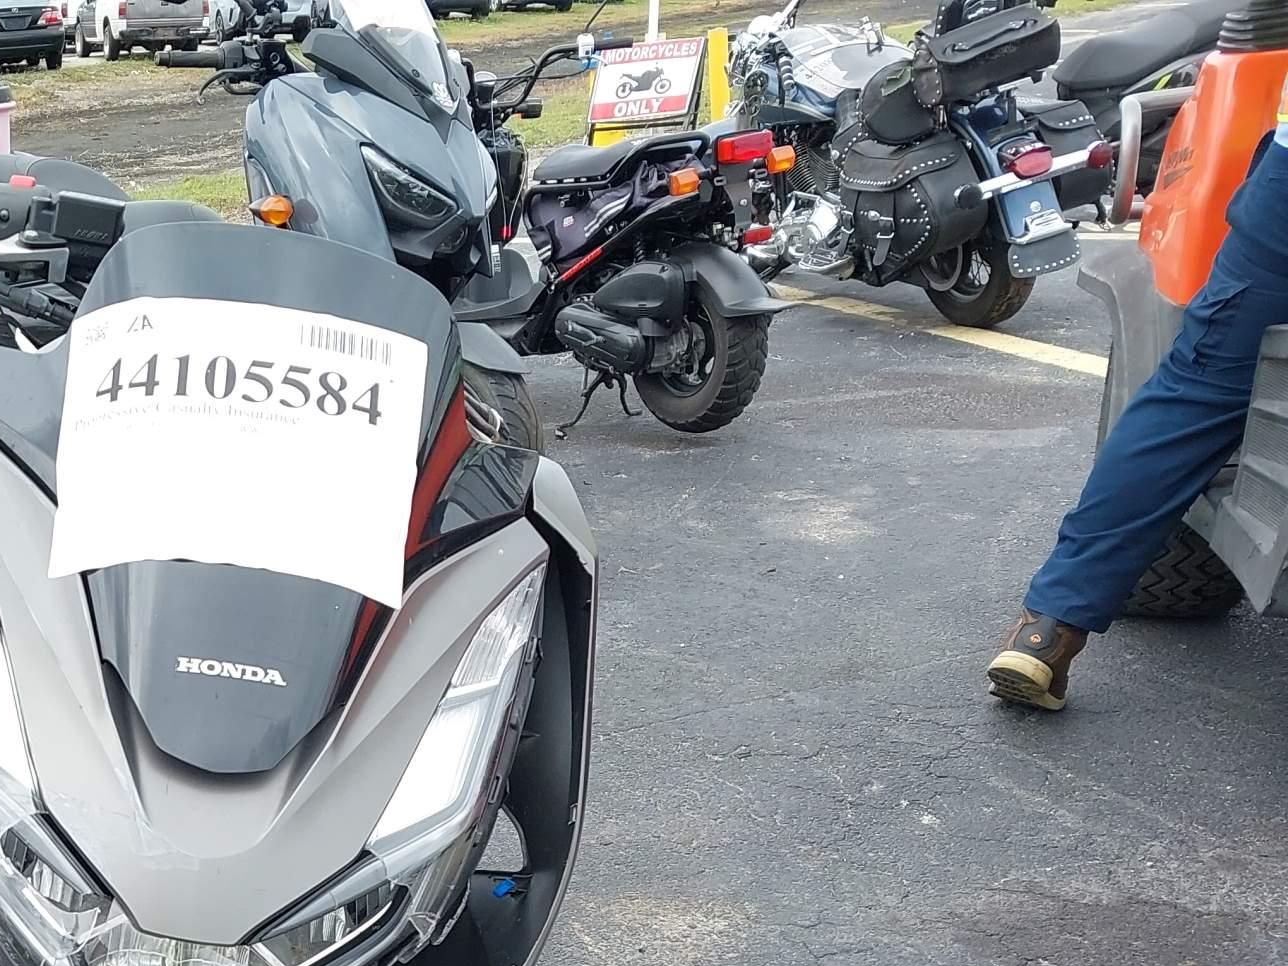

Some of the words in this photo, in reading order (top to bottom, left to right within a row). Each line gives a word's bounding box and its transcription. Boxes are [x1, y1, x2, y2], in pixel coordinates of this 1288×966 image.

[605, 42, 697, 63] MOTORCYCLES
[614, 97, 664, 117] ONLY
[95, 353, 382, 426] 44105584
[176, 656, 287, 686] HONDA
